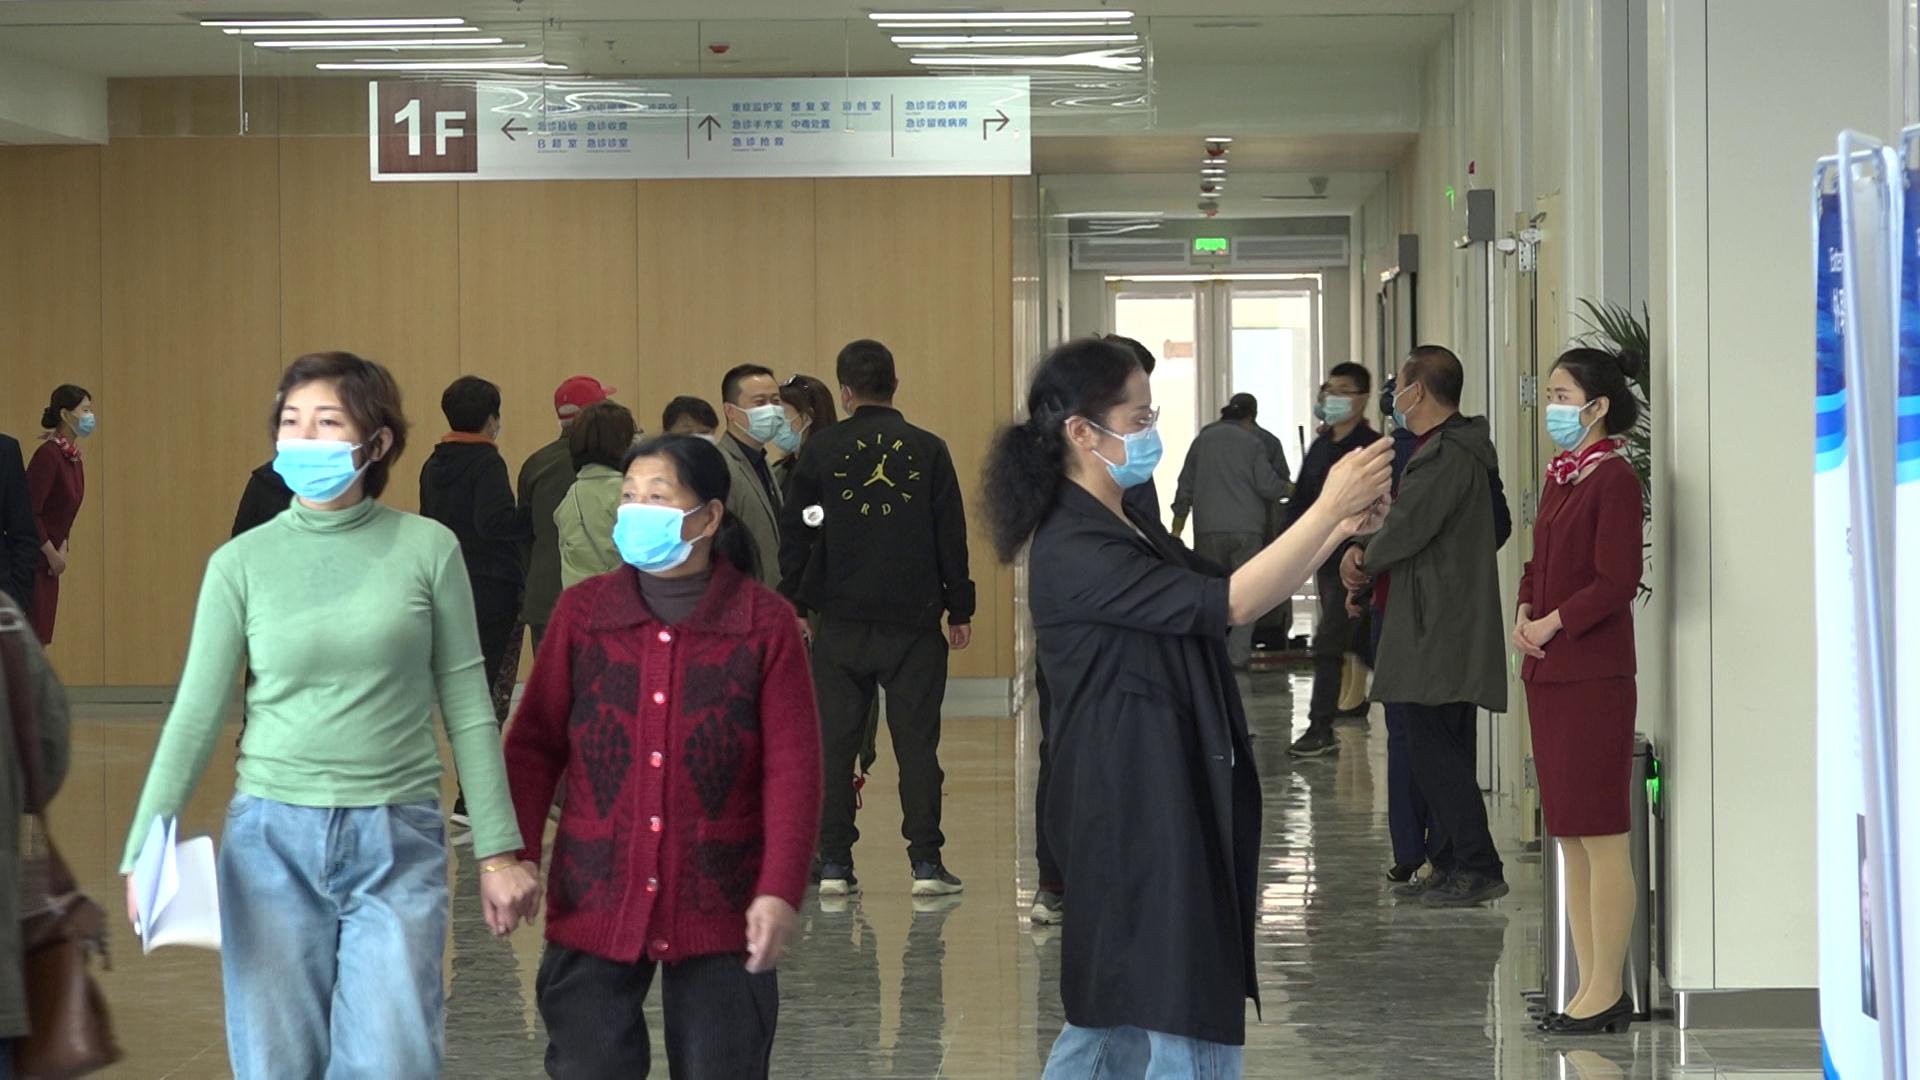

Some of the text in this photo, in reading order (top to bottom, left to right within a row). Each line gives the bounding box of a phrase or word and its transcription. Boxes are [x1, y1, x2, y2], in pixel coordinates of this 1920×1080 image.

[905, 100, 968, 111] 急诊综合病房
[394, 99, 467, 156] 1F
[586, 121, 629, 131] 急诊收费
[731, 119, 831, 130] 急诊手术室 中毒处置
[905, 118, 968, 128] 急诊留观病房
[586, 138, 629, 149] 急诊诊室
[856, 433, 904, 451] AIR
[834, 470, 921, 515] JORDAN
